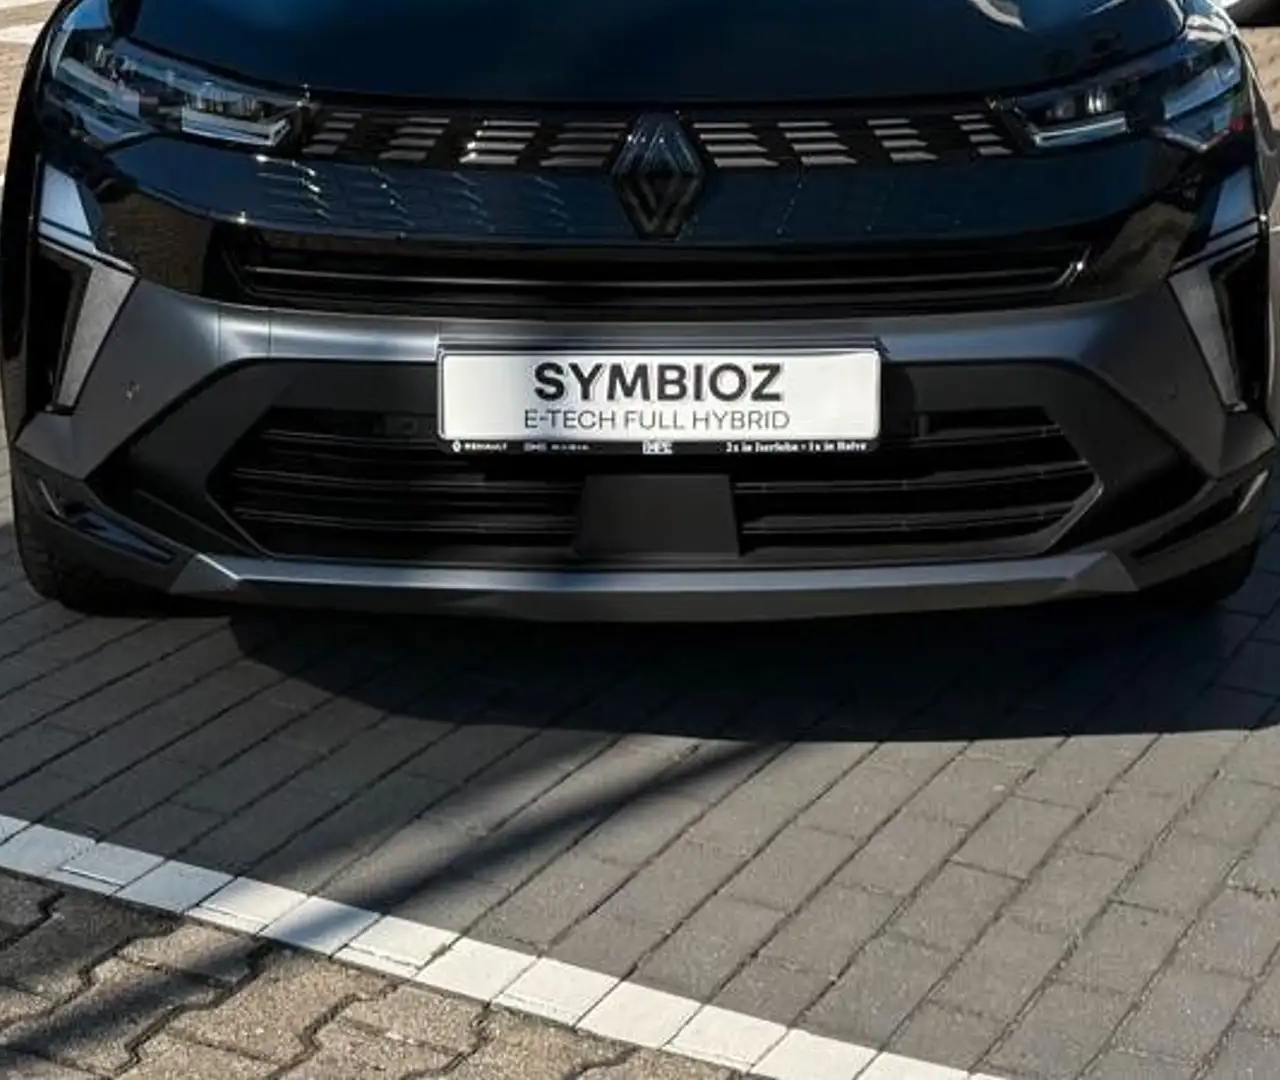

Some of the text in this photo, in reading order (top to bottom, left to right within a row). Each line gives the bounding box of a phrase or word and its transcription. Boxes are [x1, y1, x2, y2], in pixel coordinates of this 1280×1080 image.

[533, 362, 782, 402] SYMBIOZ
[524, 409, 791, 431] E-TECH FULL HYBRID
